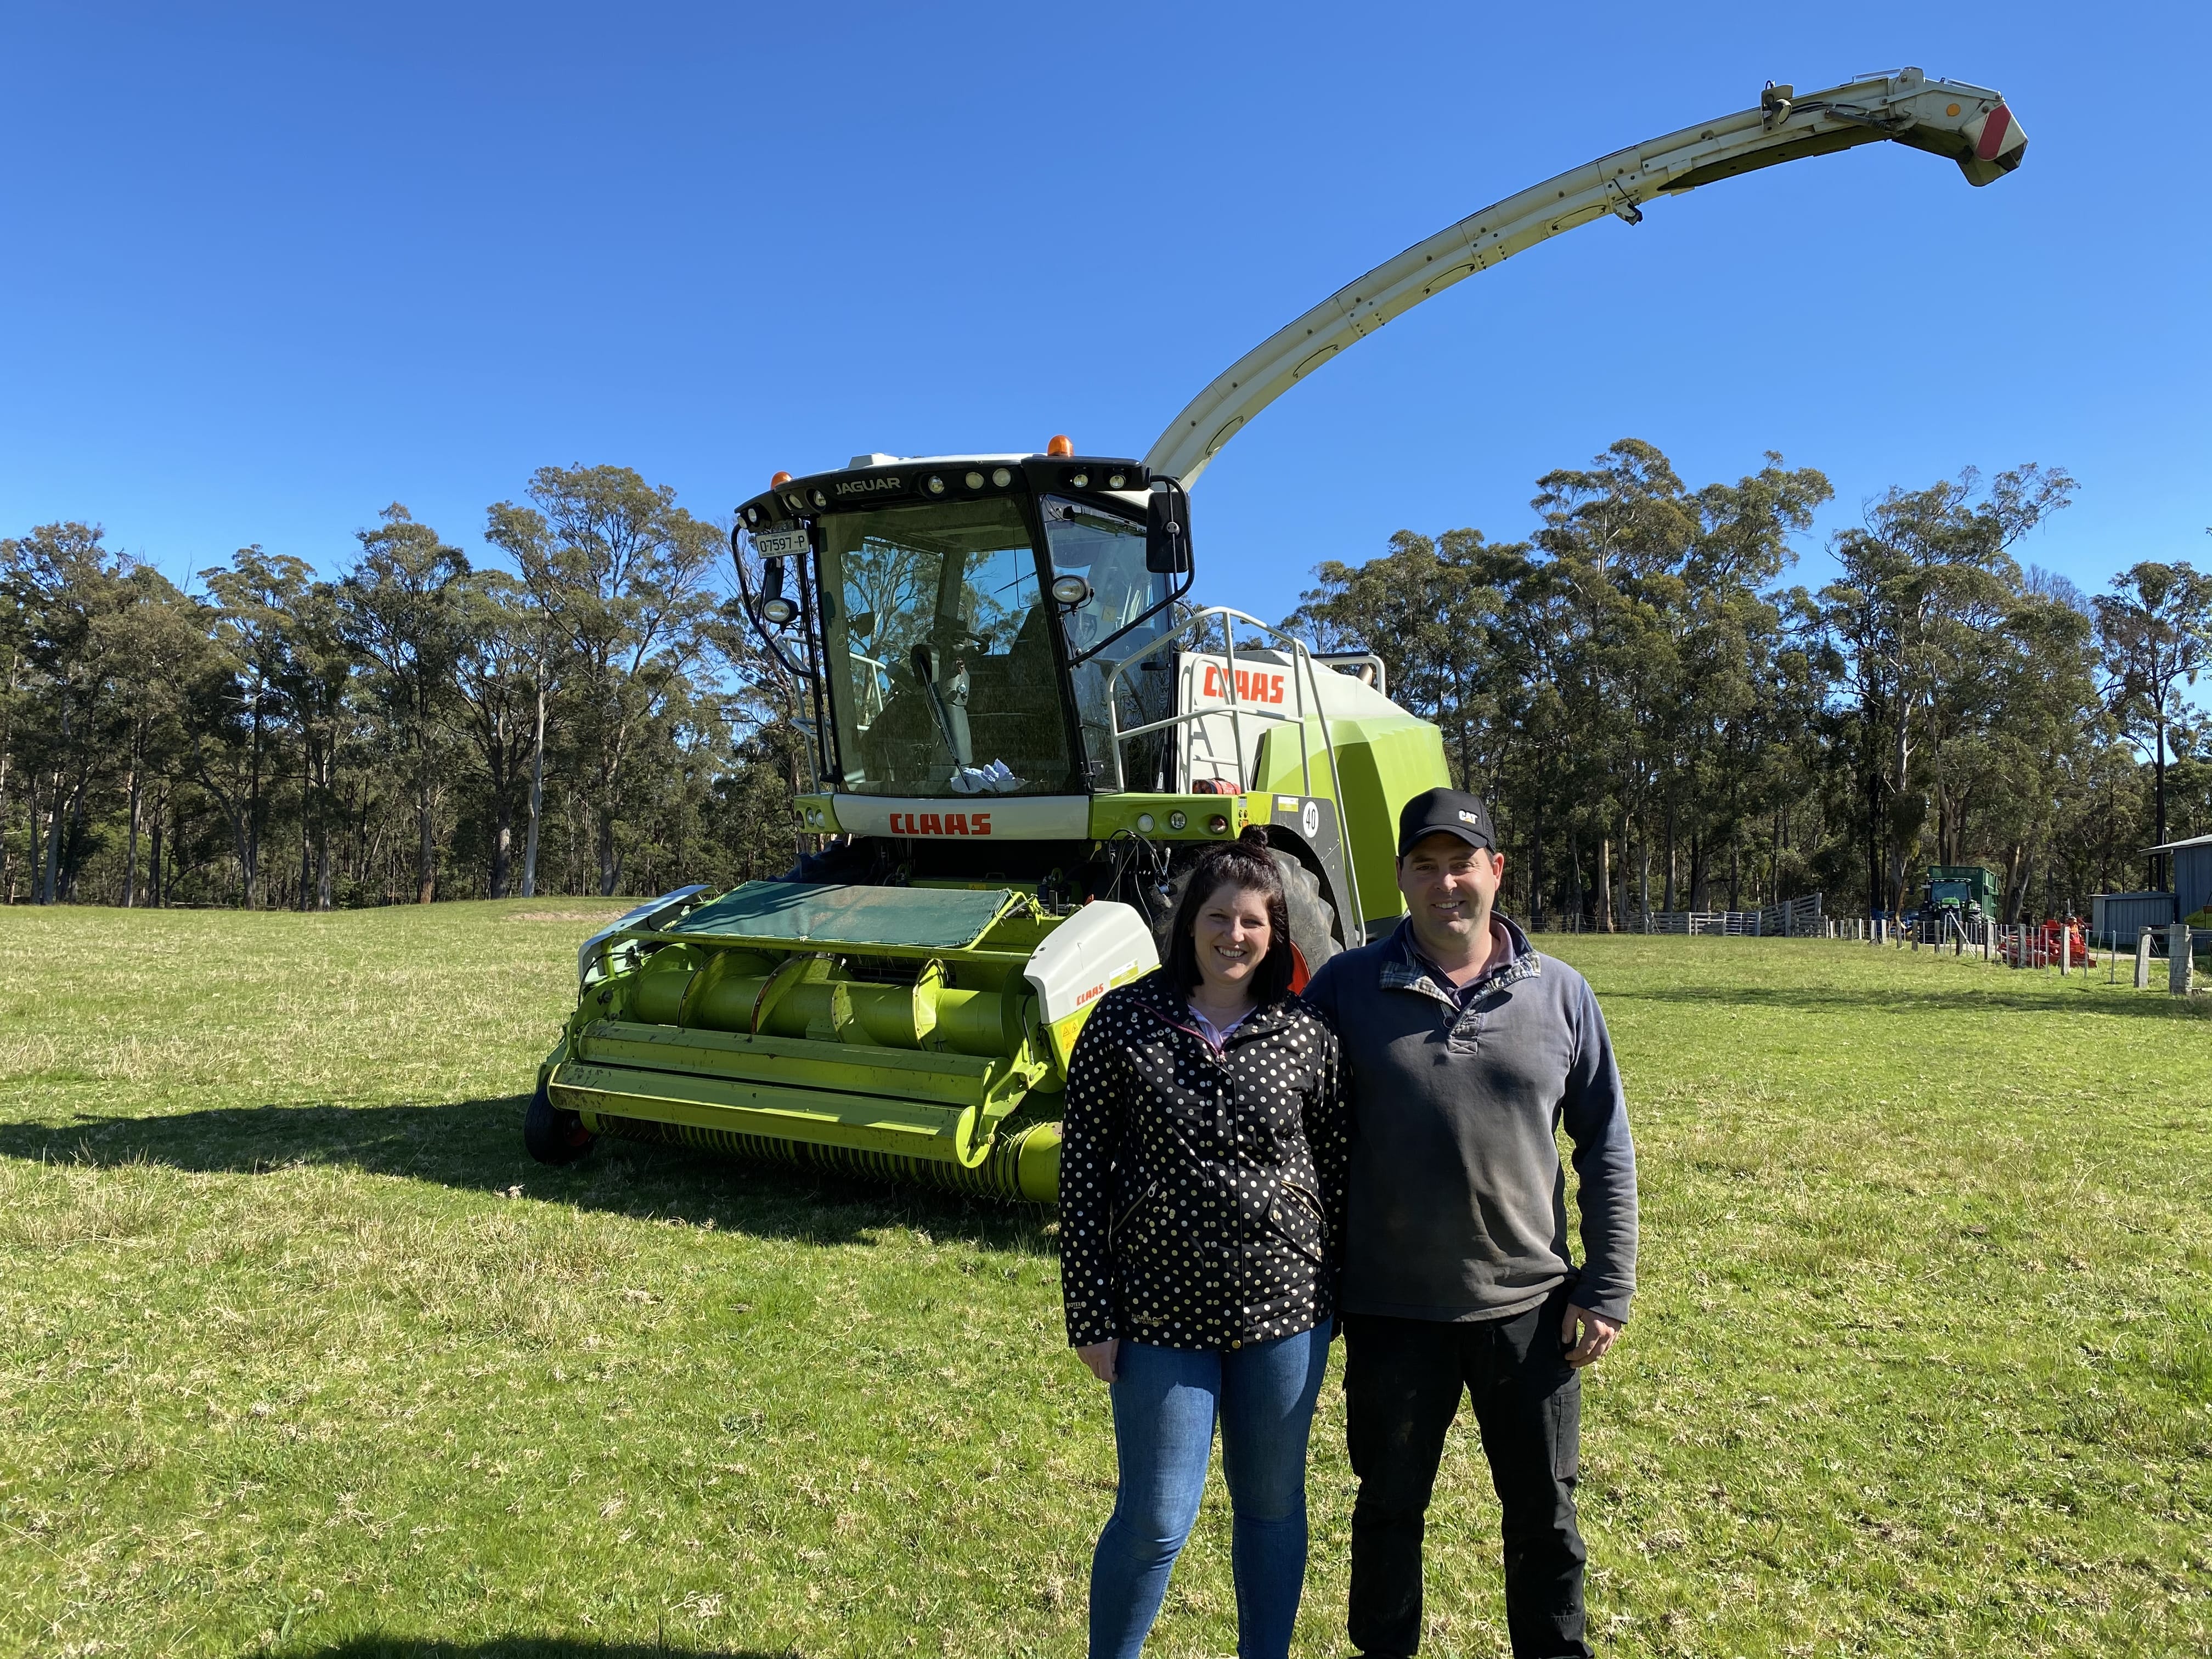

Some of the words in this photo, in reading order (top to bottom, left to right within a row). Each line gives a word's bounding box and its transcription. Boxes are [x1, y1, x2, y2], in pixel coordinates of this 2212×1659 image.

[836, 477, 901, 495] JAGUAR
[890, 813, 991, 835] CLAAS
[1306, 807, 1316, 830] 40
[1459, 810, 1478, 825] CAT
[1076, 983, 1104, 1006] CLAAS
[1132, 1313, 1152, 1321] GATTA
